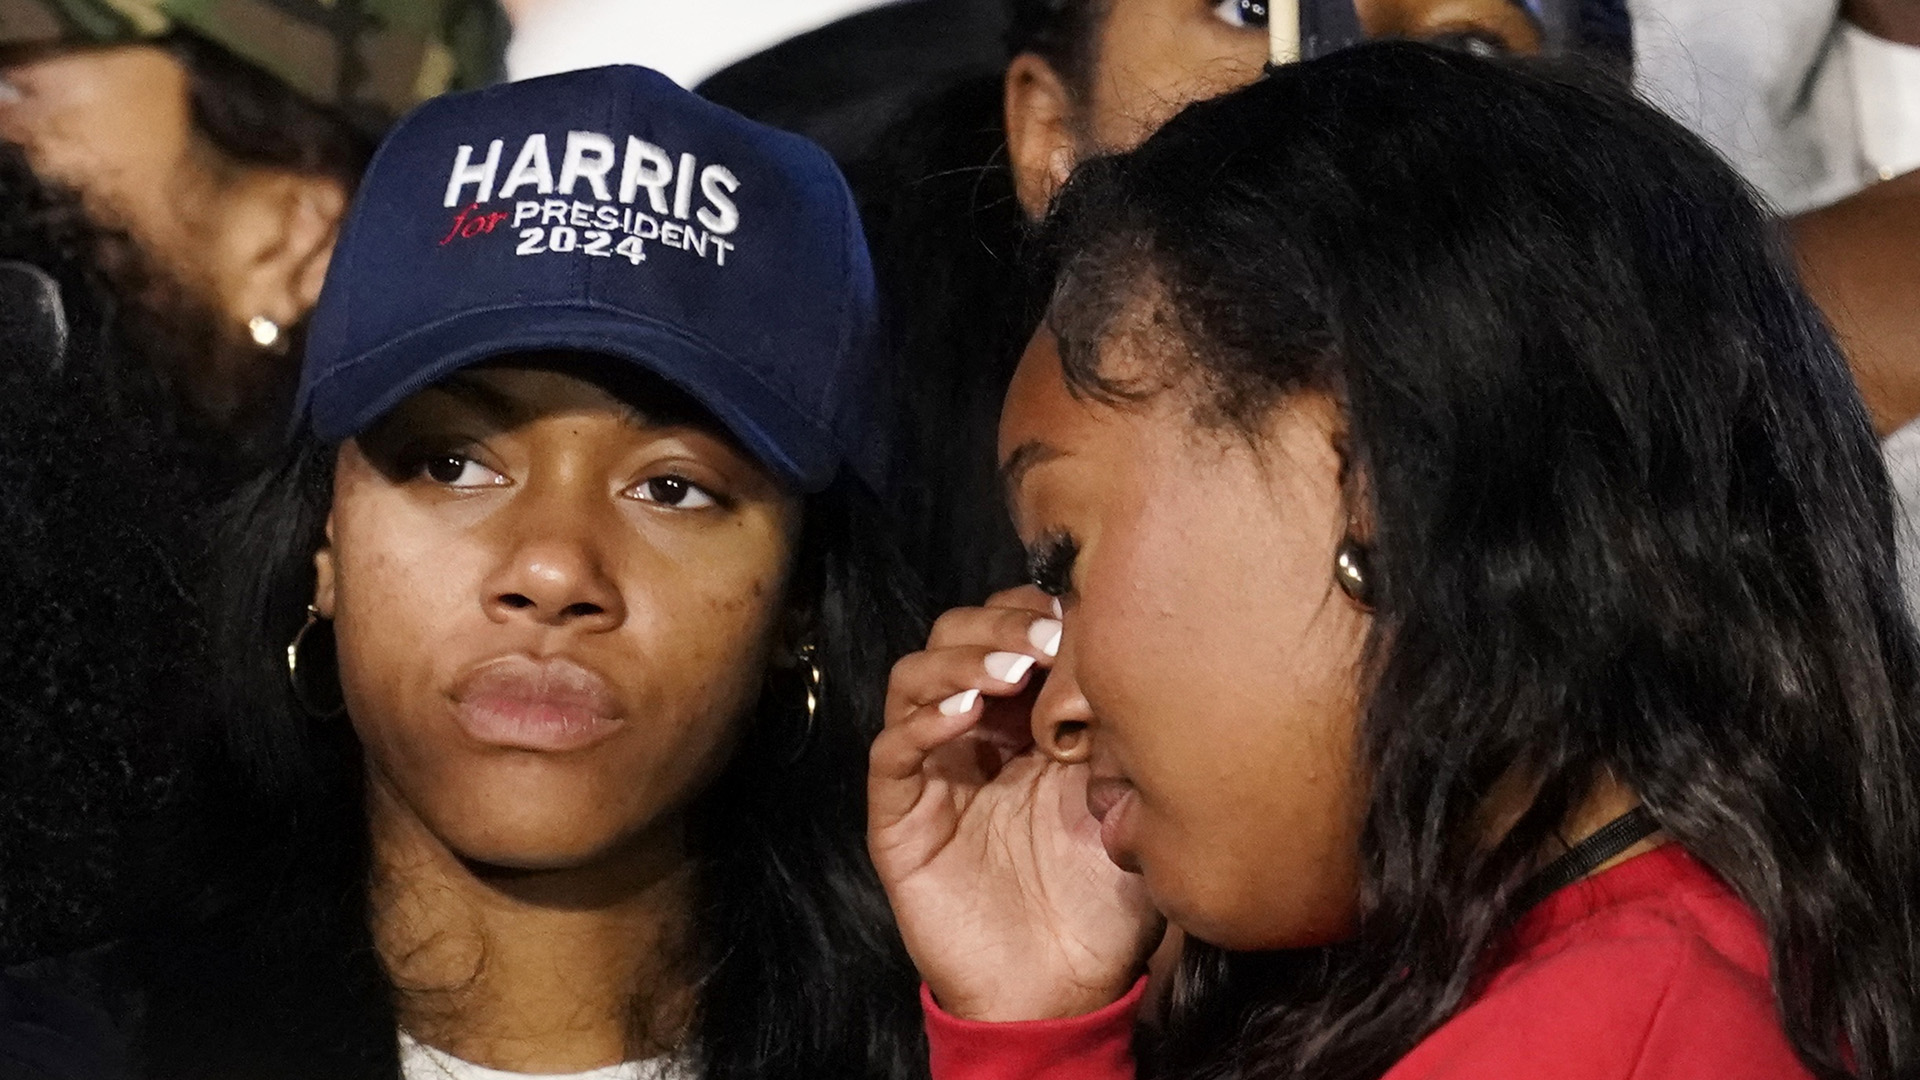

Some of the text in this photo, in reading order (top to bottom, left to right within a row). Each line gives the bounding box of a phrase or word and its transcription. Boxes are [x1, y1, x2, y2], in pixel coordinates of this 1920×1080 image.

[443, 130, 741, 234] HARRIS
[439, 199, 735, 266] for PRESIDENT
